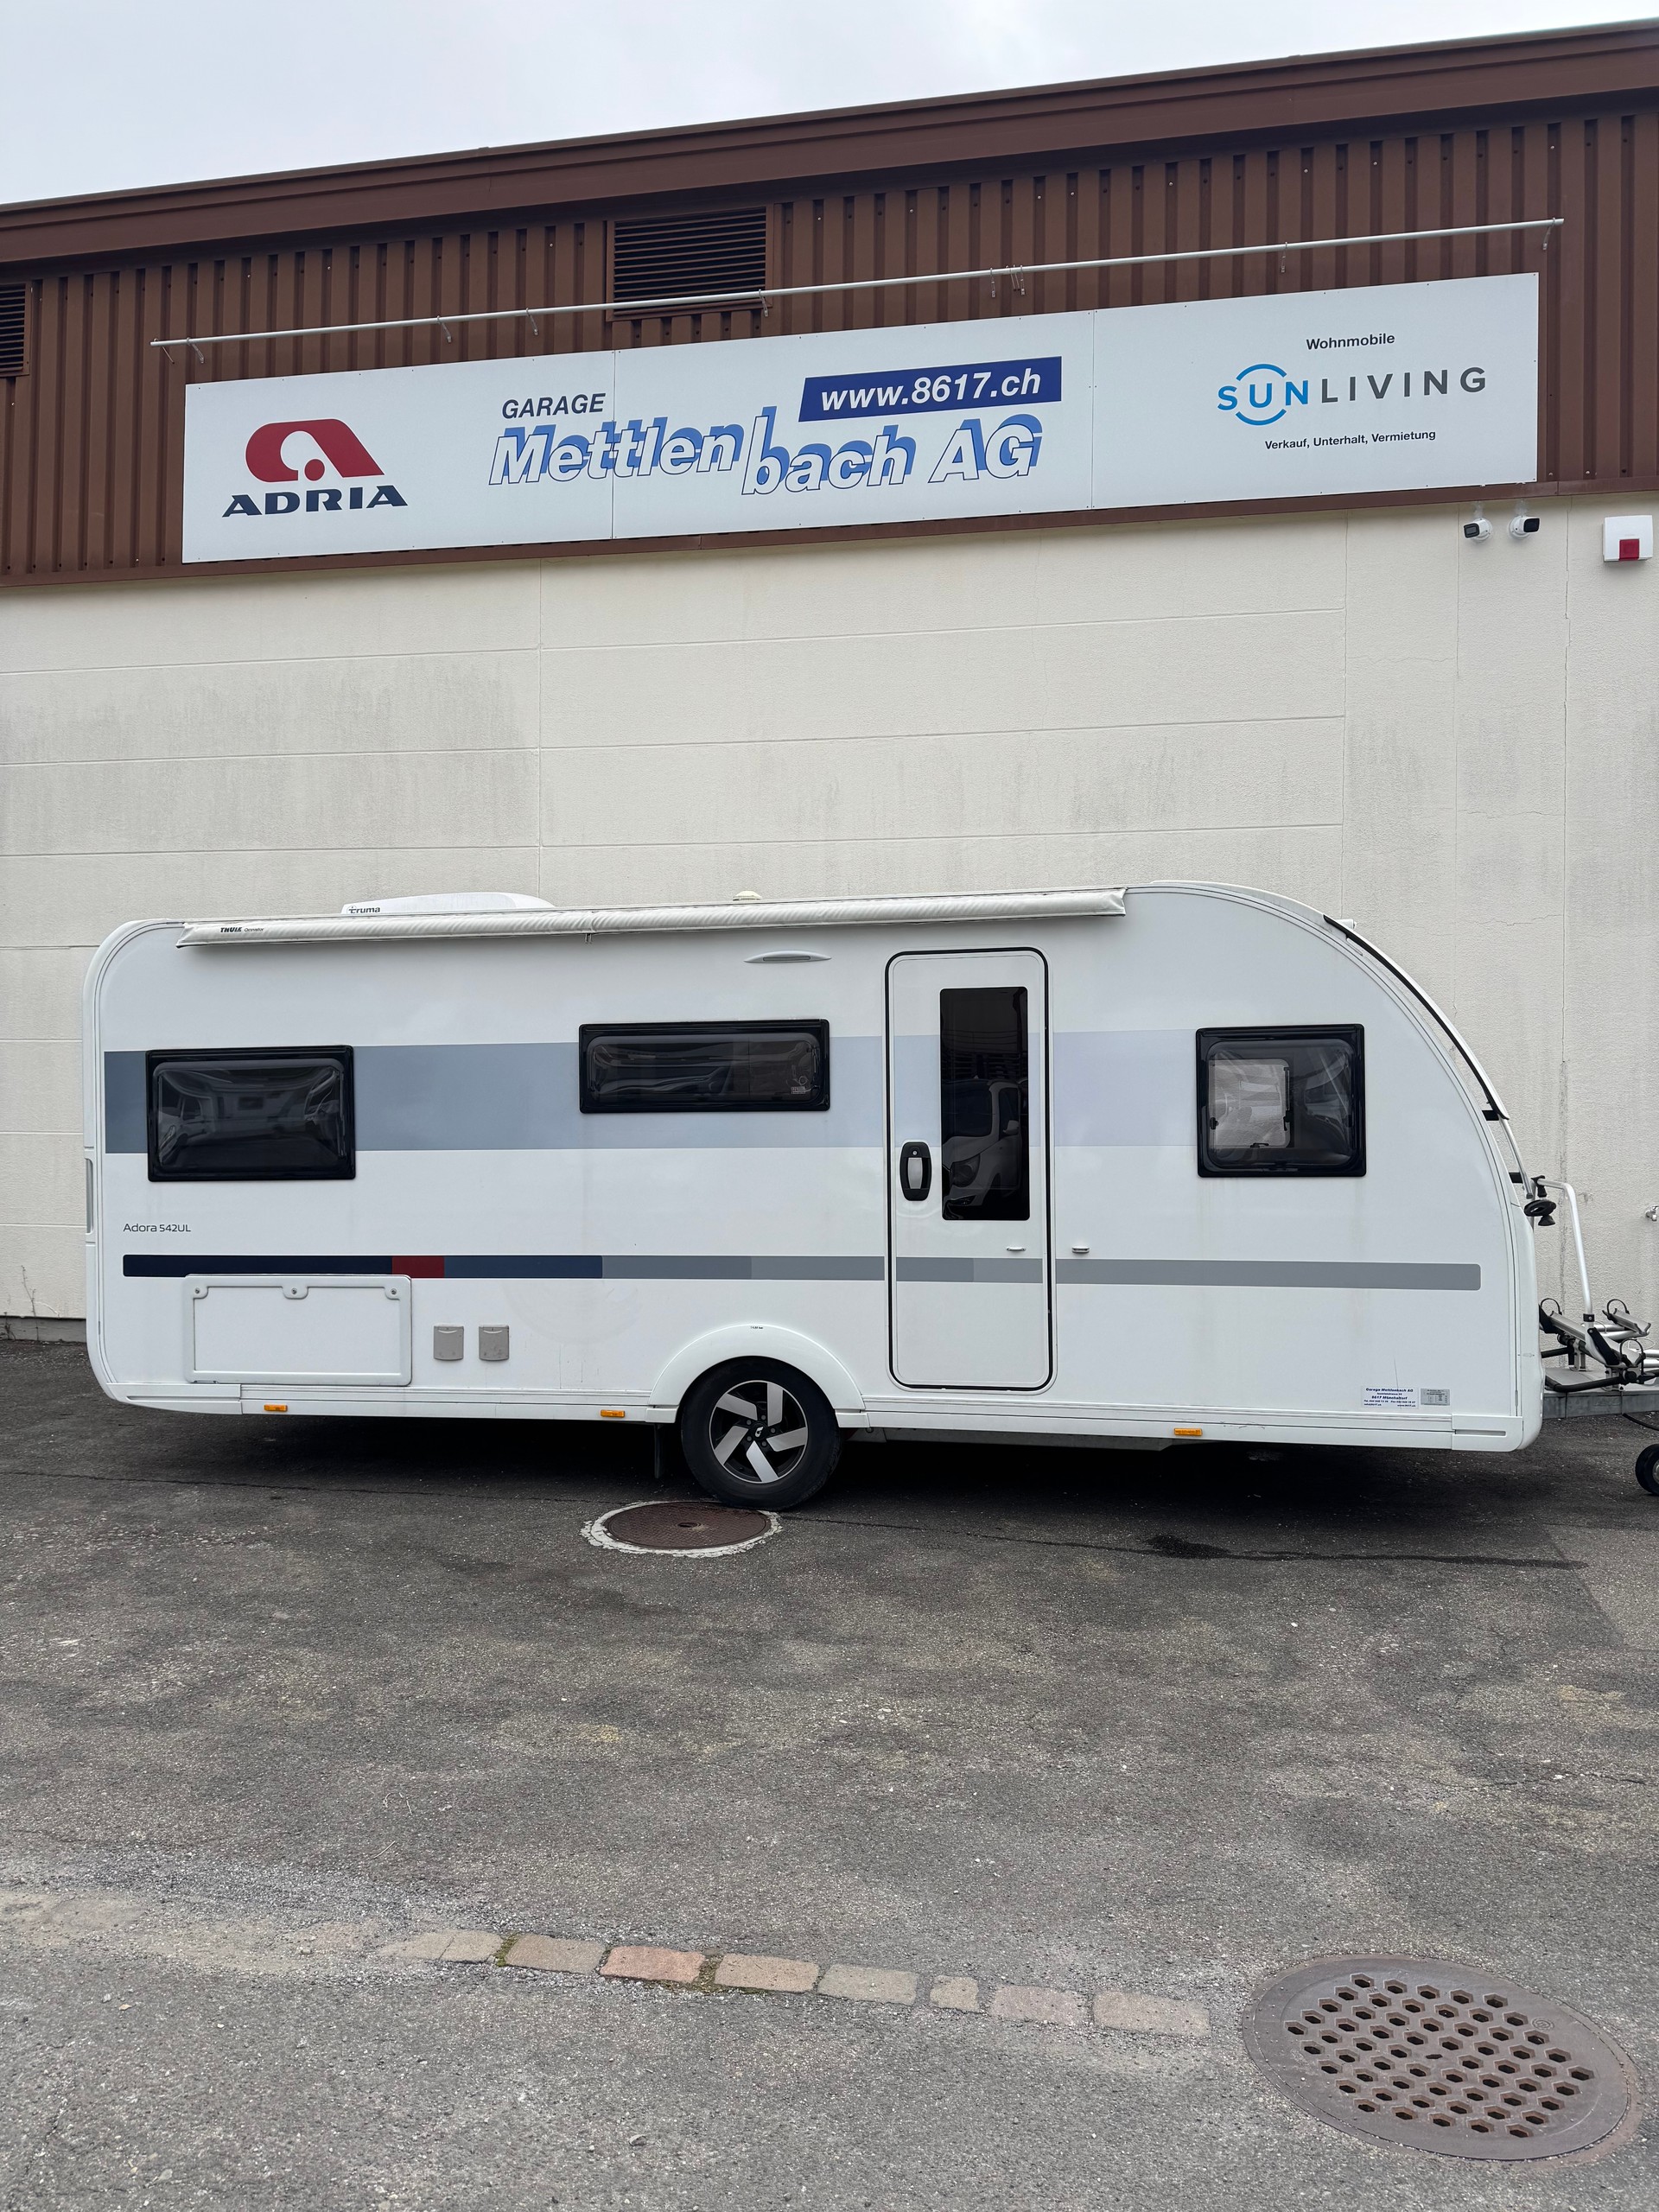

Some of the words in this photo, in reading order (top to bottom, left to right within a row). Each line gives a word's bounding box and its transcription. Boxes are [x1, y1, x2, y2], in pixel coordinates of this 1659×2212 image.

[1306, 334, 1395, 351] Wohnmobile
[819, 367, 1042, 413] www.8617.ch
[1217, 366, 1486, 412] SUNLIVING
[503, 393, 607, 419] GARAGE
[489, 406, 917, 495] Mettlenbach
[928, 413, 1044, 485] AG
[1264, 437, 1311, 450] Verkauf,
[1313, 434, 1369, 447] Unterhalt,
[1371, 431, 1436, 444] Vermietung
[222, 485, 409, 518] ADRIA
[123, 1223, 157, 1233] Adora
[159, 1224, 192, 1233] 542UL
